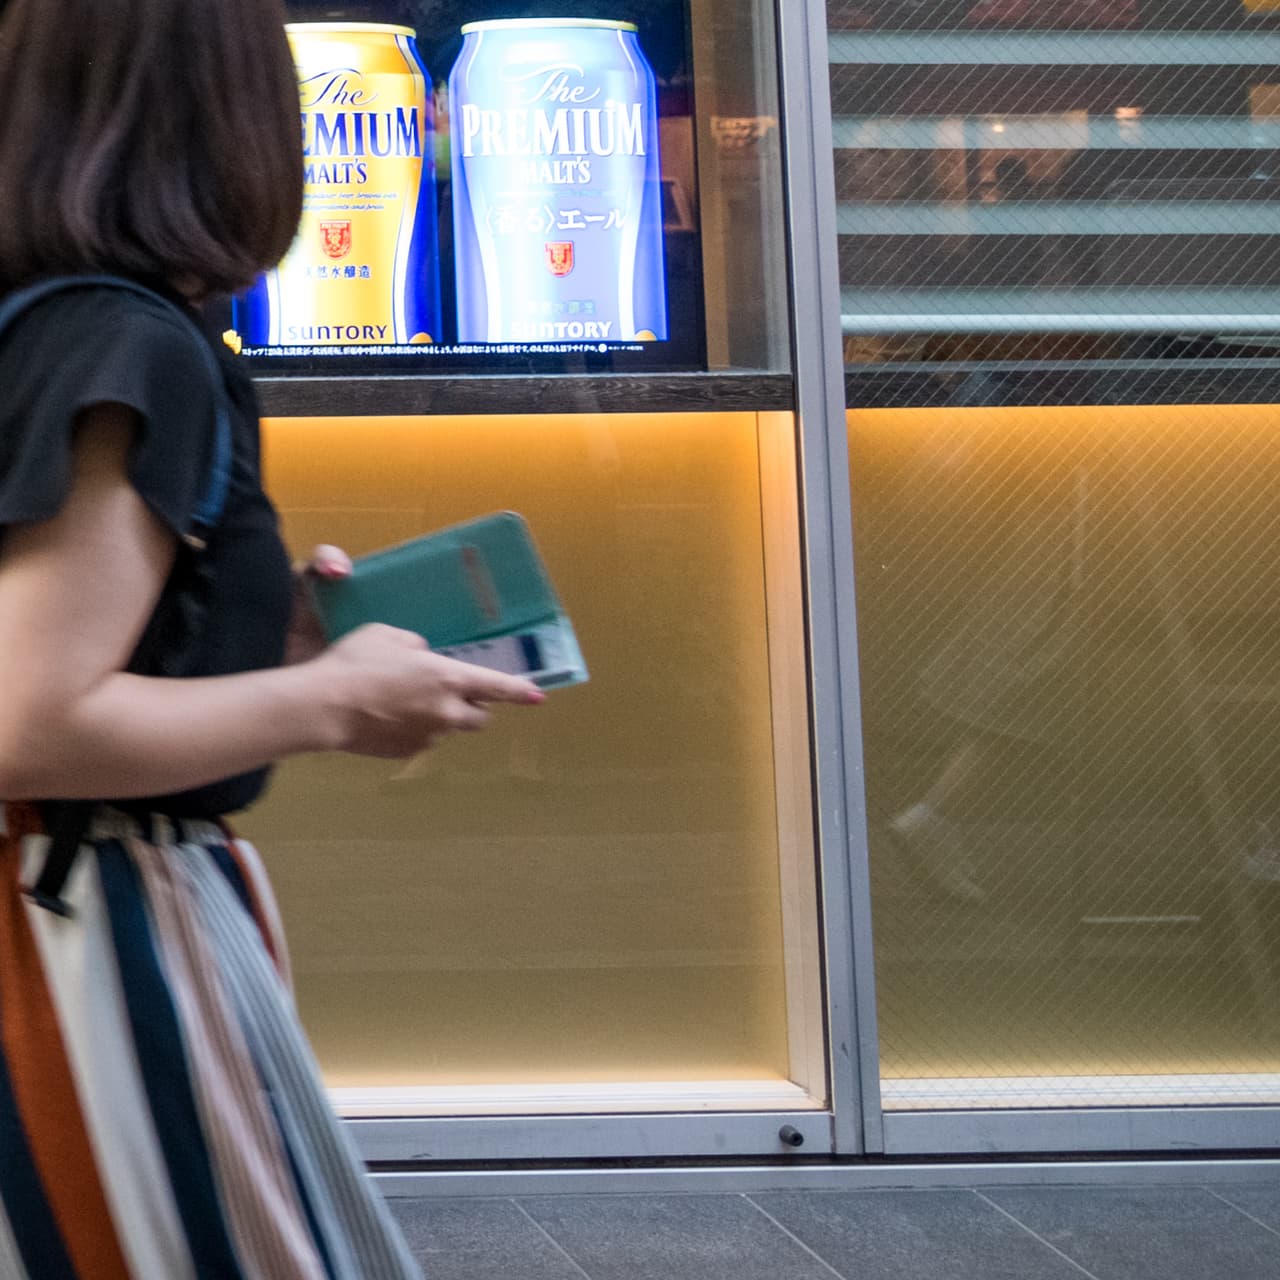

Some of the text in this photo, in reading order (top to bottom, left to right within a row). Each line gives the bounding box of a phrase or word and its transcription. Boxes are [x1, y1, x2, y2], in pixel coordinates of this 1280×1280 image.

[499, 63, 601, 104] The
[301, 106, 422, 158] EMIUM
[462, 103, 646, 157] PREMIUM
